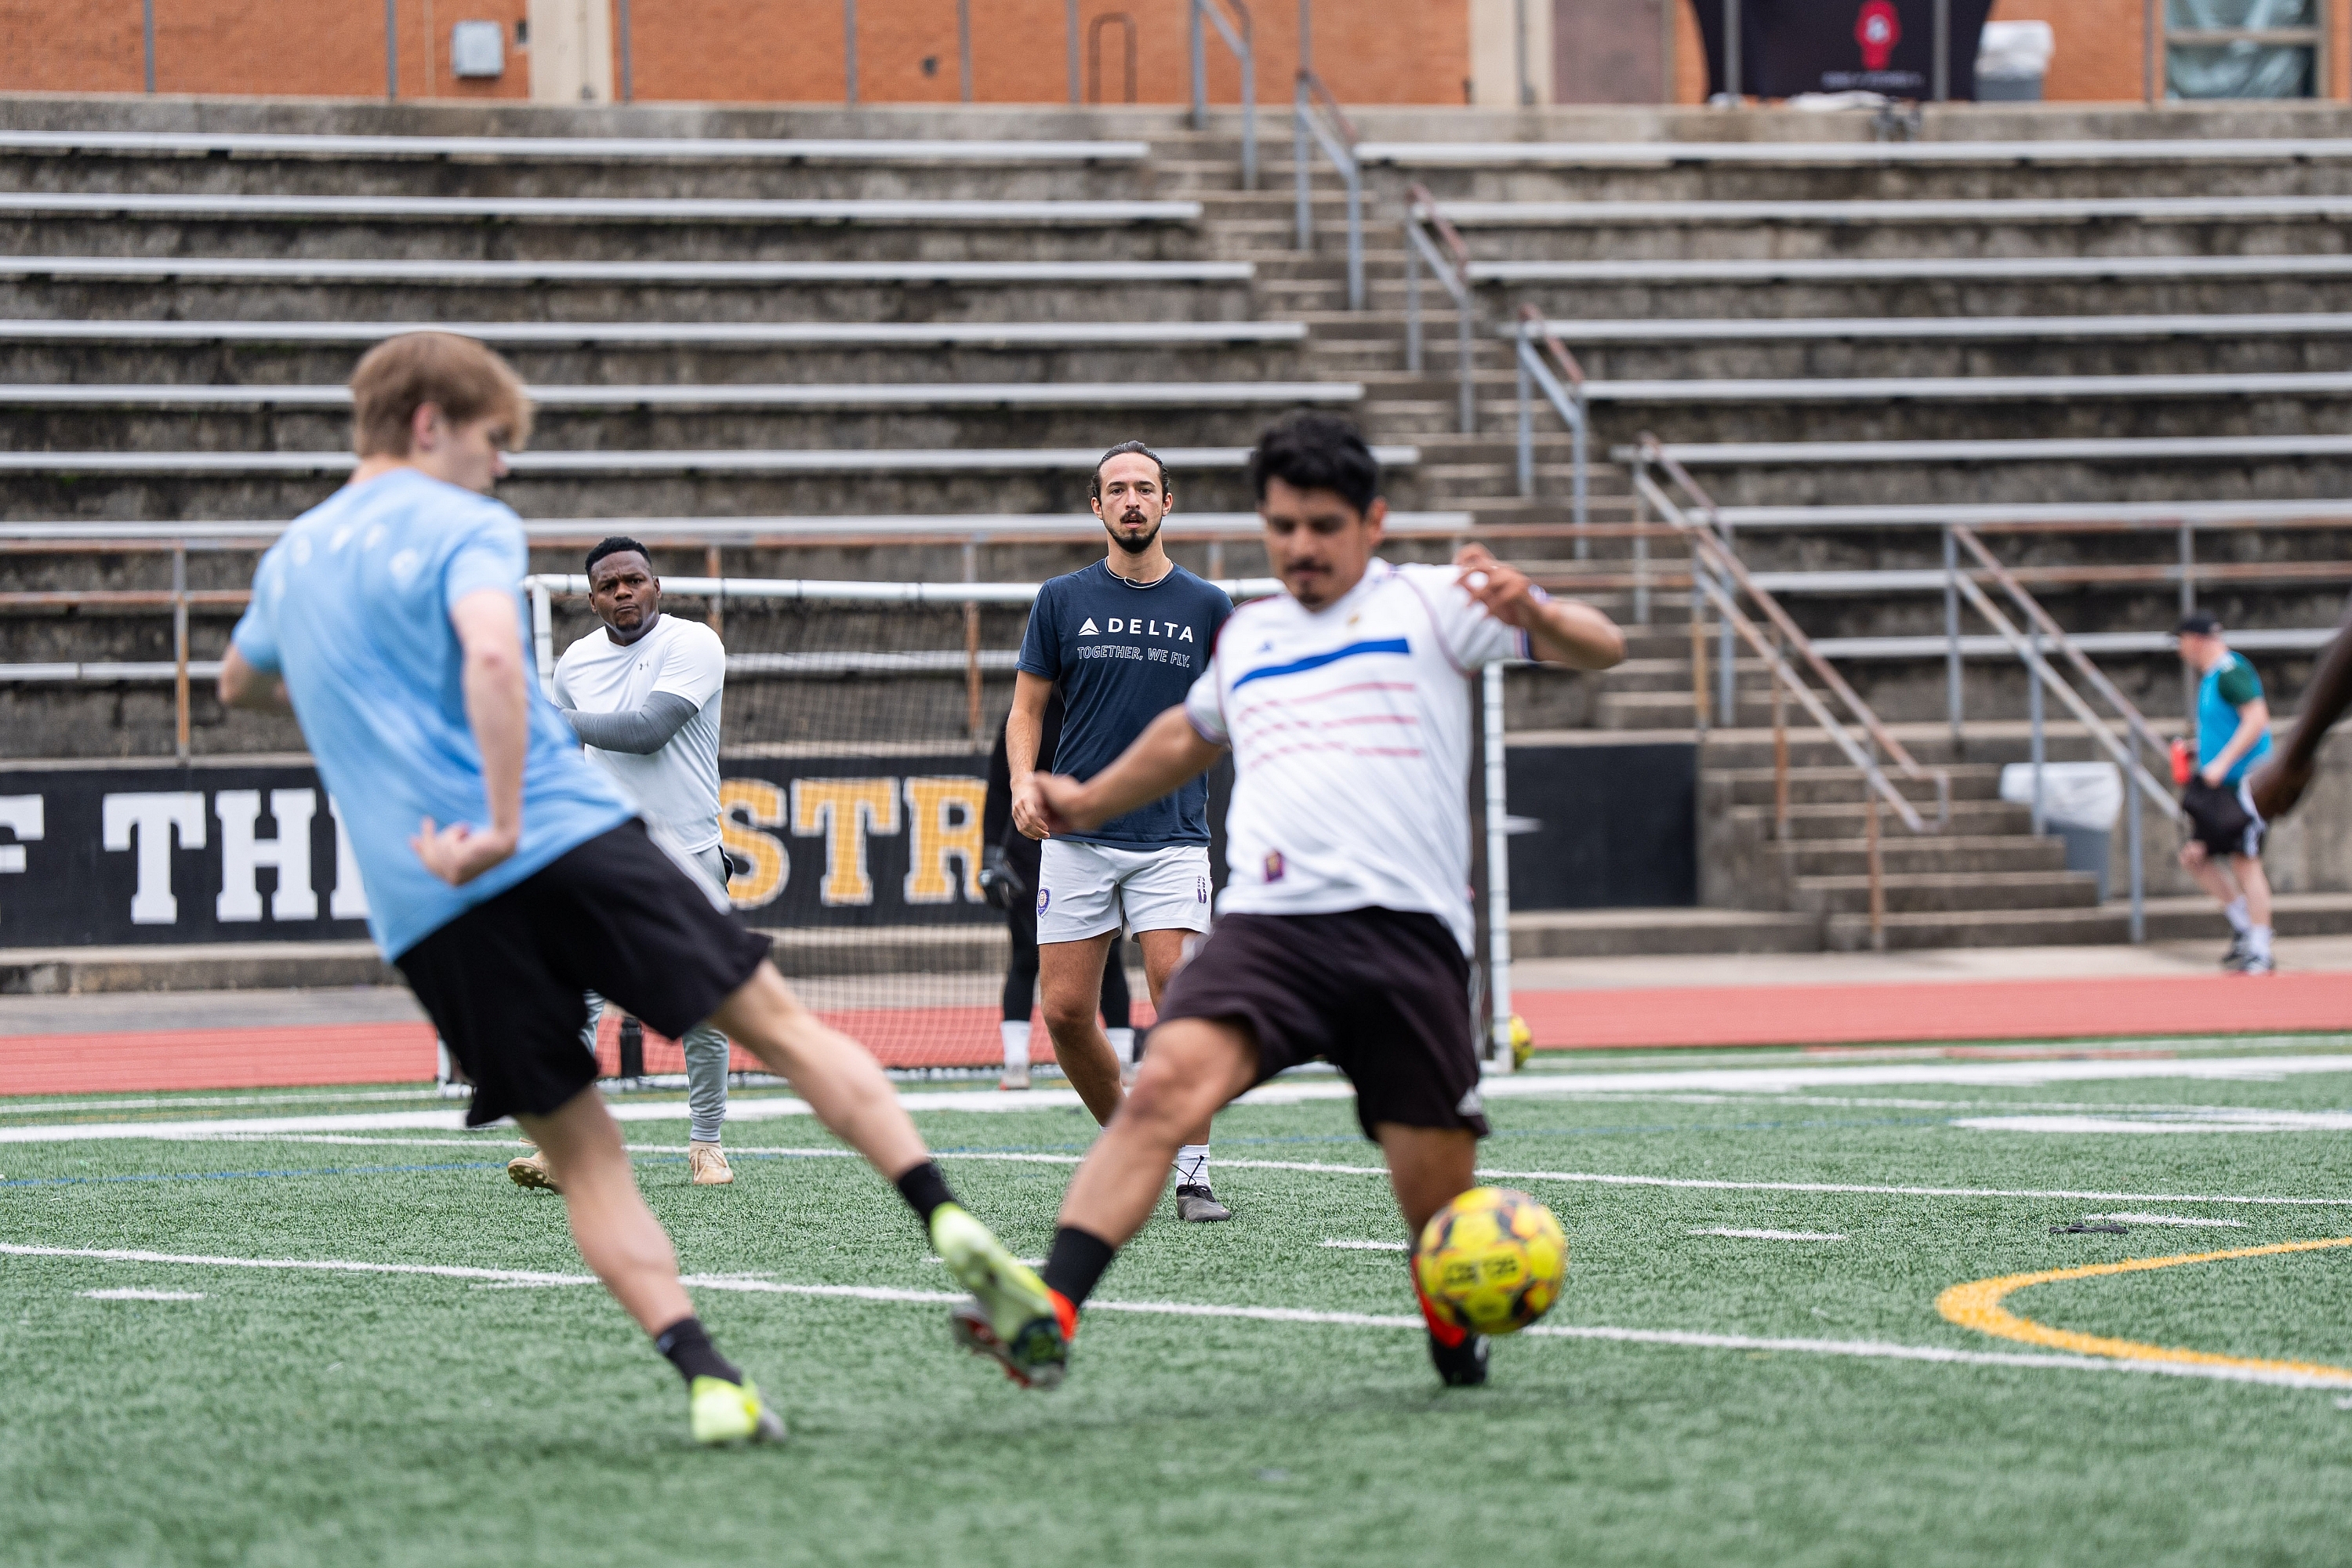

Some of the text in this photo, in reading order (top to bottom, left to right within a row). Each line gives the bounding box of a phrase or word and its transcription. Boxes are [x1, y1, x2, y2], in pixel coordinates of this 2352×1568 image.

[1108, 618, 1193, 643] DELTA
[1077, 645, 1190, 668] TOGETHER, WE FLY.
